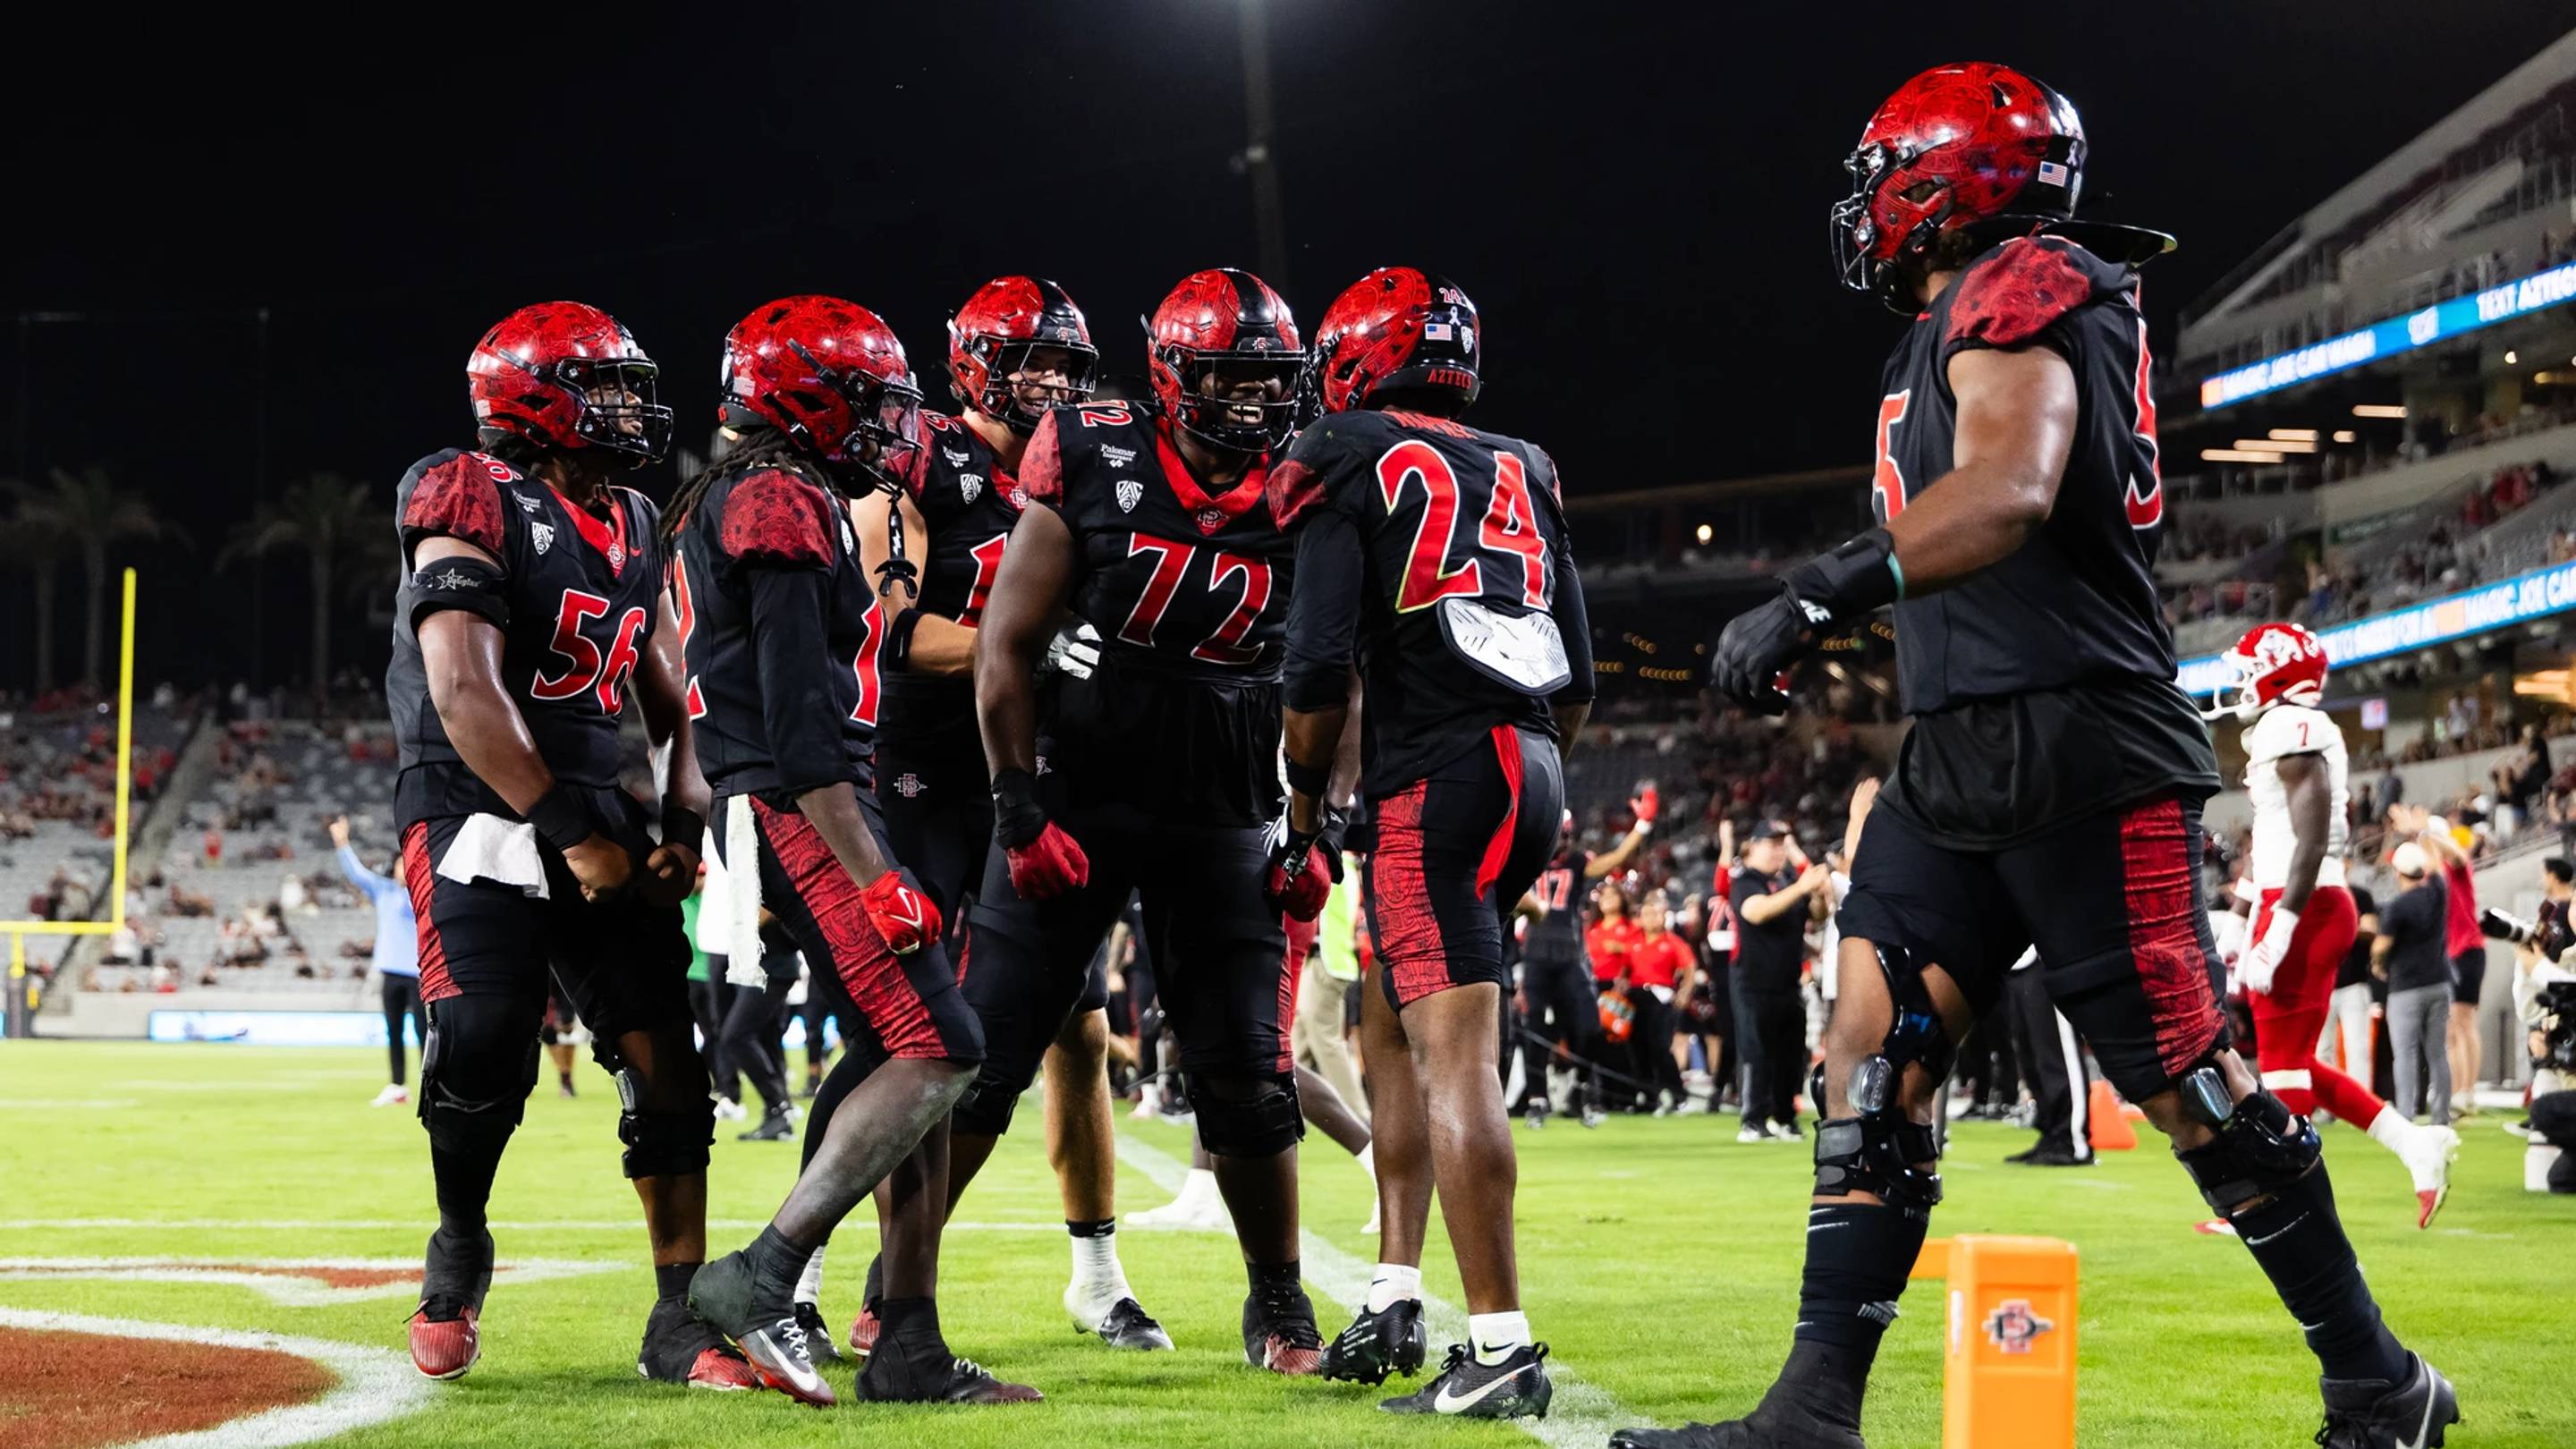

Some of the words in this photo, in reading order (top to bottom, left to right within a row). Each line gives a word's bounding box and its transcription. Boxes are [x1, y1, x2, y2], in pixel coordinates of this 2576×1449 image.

[2477, 284, 2517, 322] TEXT
[1428, 369, 1473, 389] AZTECS
[1100, 444, 1137, 457] Palomar
[1377, 439, 1549, 614] 24
[1118, 532, 1273, 665] 72
[2516, 574, 2547, 615] JOE
[530, 589, 647, 716] 56
[2297, 722, 2309, 747] 7
[1535, 869, 1573, 911] 17
